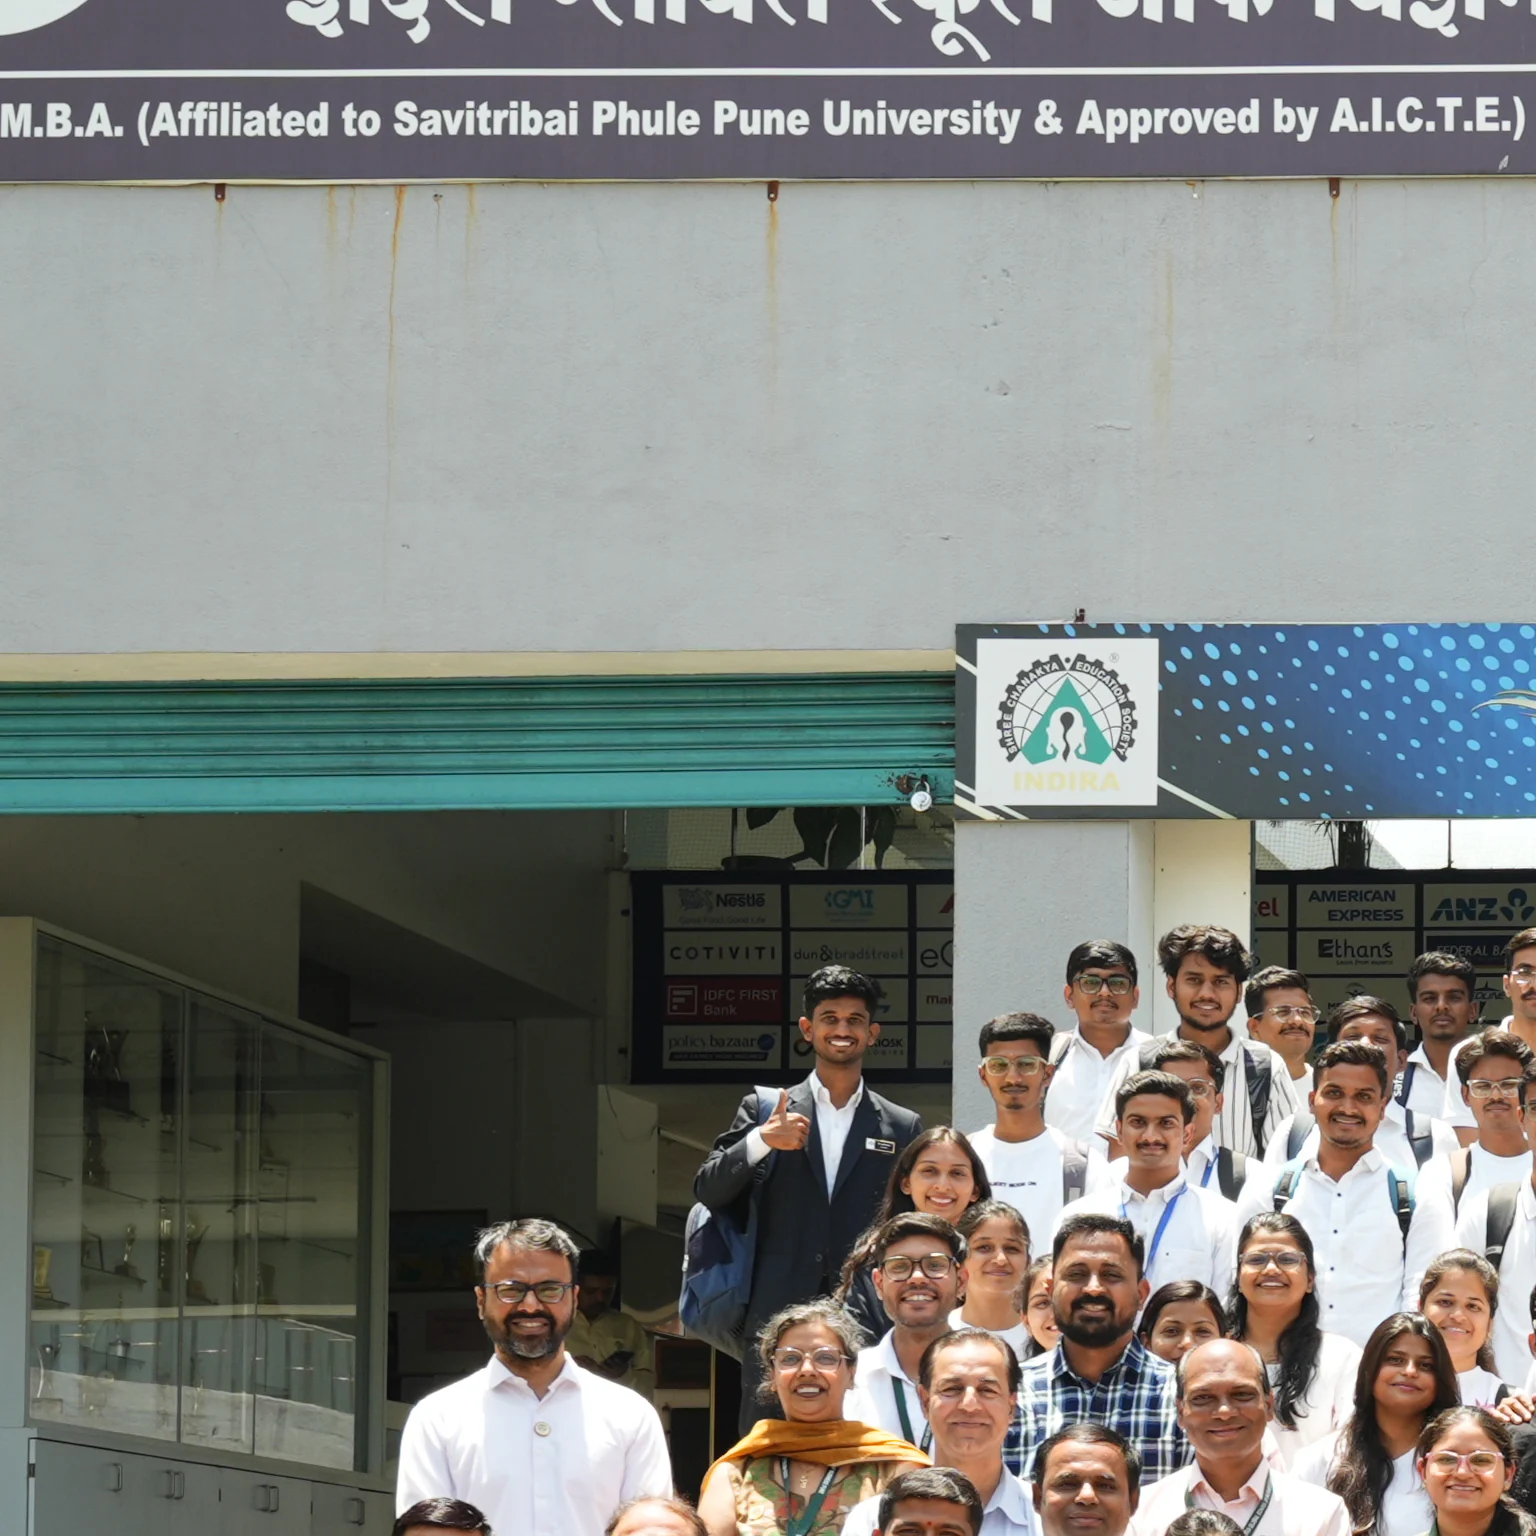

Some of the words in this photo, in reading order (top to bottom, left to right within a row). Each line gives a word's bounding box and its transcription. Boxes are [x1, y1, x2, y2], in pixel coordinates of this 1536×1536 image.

[0, 103, 123, 137] M.B.A.
[137, 101, 329, 146] (Affiliated
[342, 102, 381, 137] to
[393, 100, 579, 137] Savitribai
[593, 100, 701, 137] Phule
[714, 100, 810, 136] Pune
[823, 99, 1022, 144] University
[1034, 99, 1064, 135] &
[1076, 99, 1260, 144] Approved
[1273, 98, 1319, 142] by
[1330, 95, 1527, 142] A.I.C.T.E.)
[1006, 661, 1060, 709] CHANAKYA
[1075, 661, 1127, 704] EDUCATION
[1116, 707, 1132, 756] SOCIETY
[1014, 772, 1120, 791] INDIRA
[1309, 890, 1396, 902] AMERICAN
[1328, 910, 1404, 921] EXPRESS
[1430, 898, 1498, 921] ANZ
[669, 946, 776, 960] COTIVITI
[1318, 939, 1394, 958] Ethan's
[704, 989, 735, 1001] IDFC
[739, 989, 778, 1001] FIRST
[704, 1004, 737, 1017] Bank
